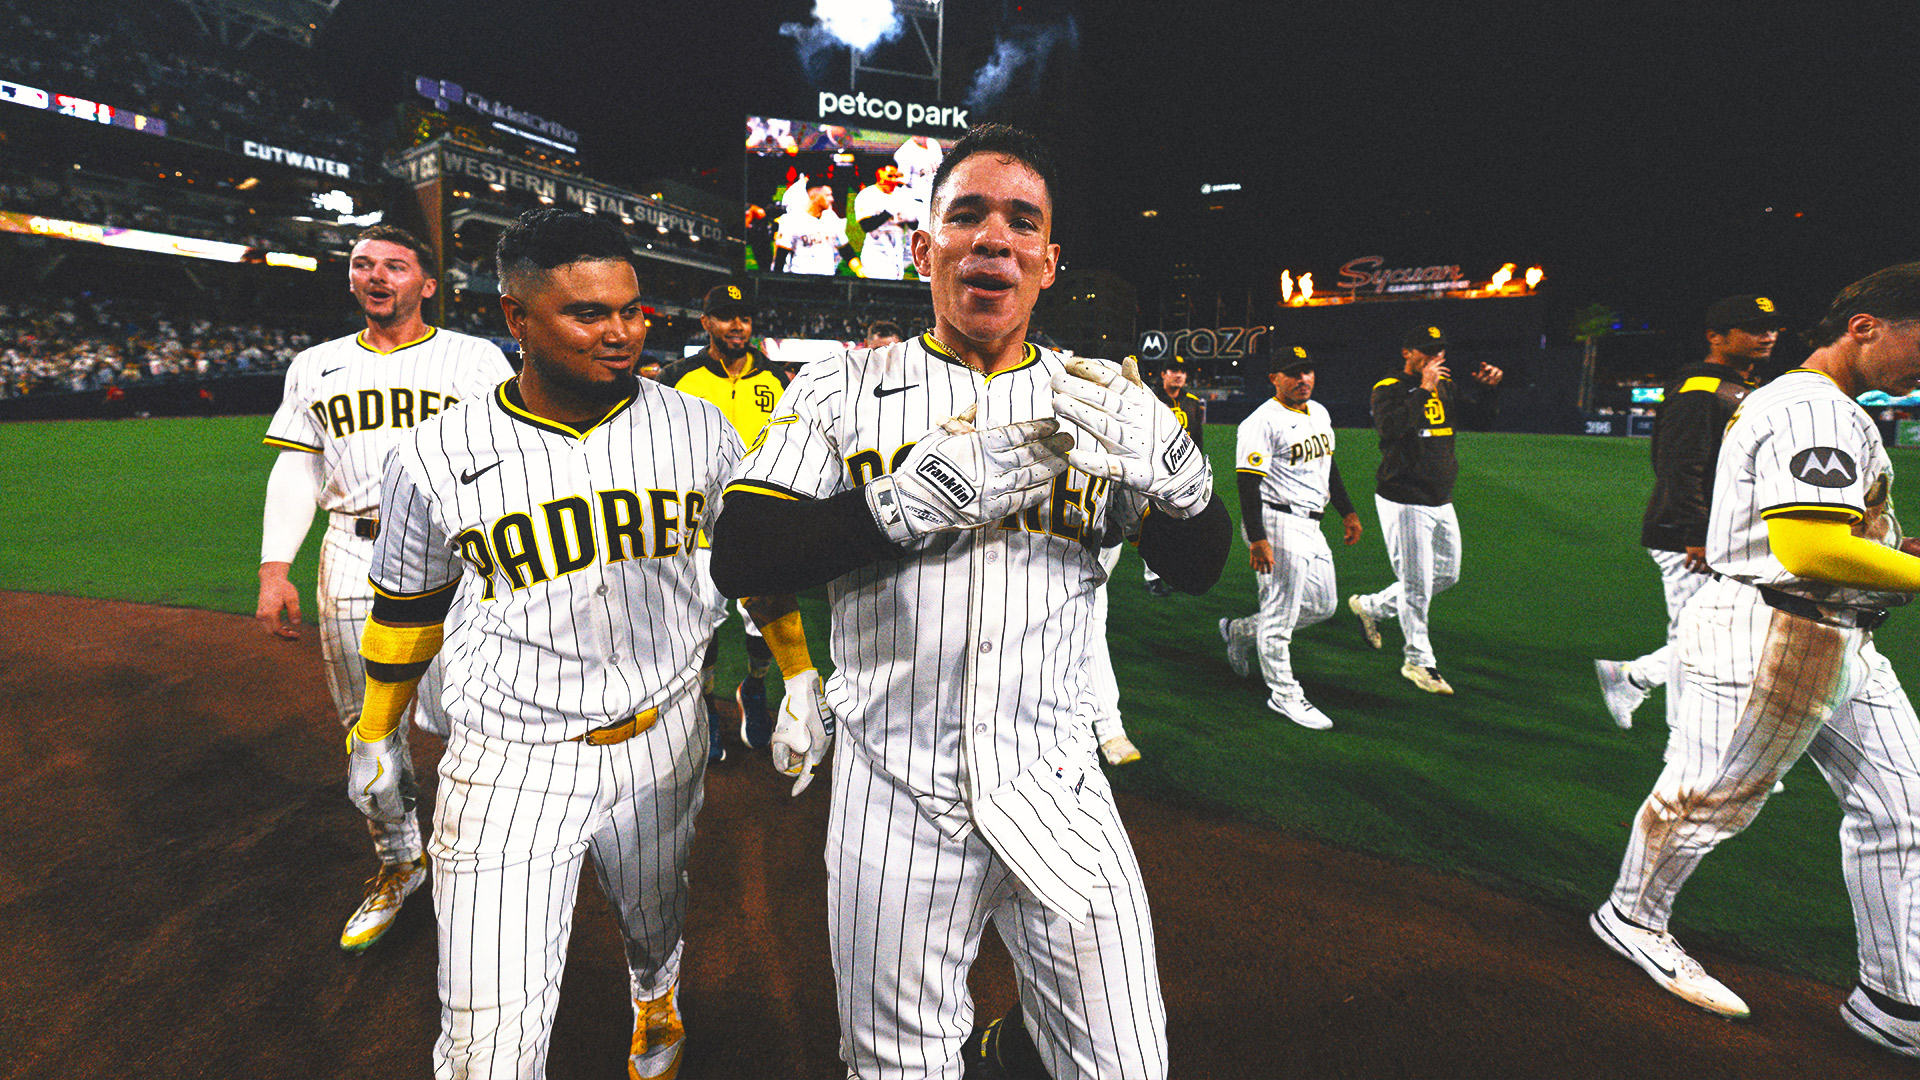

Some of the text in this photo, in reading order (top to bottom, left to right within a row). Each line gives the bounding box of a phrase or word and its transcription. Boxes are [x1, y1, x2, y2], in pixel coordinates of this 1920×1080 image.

[819, 91, 969, 129] petco park
[243, 140, 351, 179] CUTWATER
[443, 151, 557, 199] WESTERN
[566, 185, 630, 218] METAL
[633, 205, 696, 235] SUPPLY
[1337, 255, 1464, 294] Sycuan
[1174, 325, 1267, 359] razr
[309, 387, 460, 439] PADRE
[754, 384, 775, 413] SD
[1290, 433, 1334, 467] PADR
[919, 460, 970, 503] Franklin
[457, 487, 706, 603] PADRES
